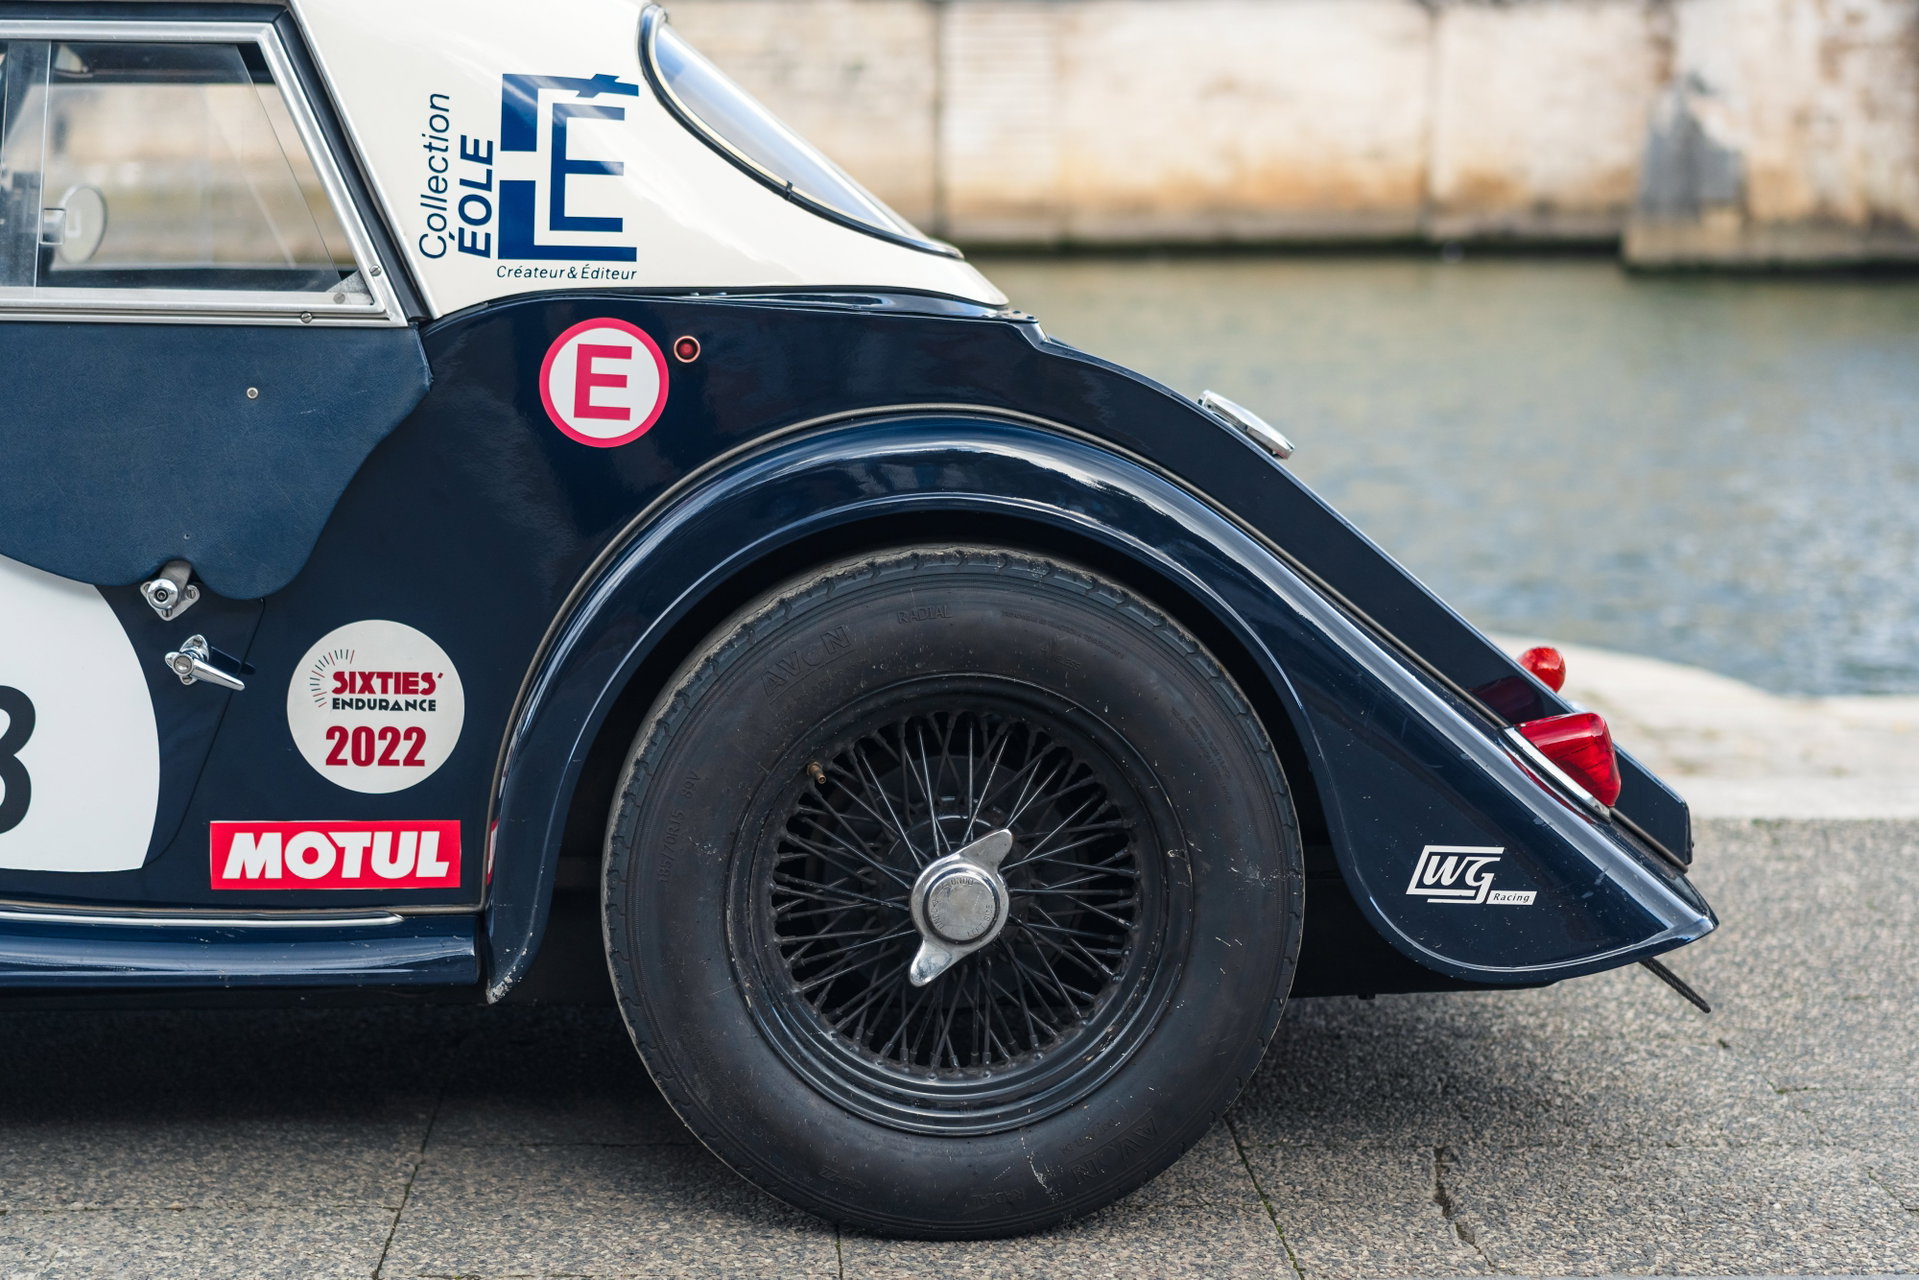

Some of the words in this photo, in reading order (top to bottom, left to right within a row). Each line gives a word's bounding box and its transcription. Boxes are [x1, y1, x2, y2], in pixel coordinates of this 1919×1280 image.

[418, 93, 450, 259] Collection
[449, 134, 494, 259] ÉOLE
[573, 343, 633, 421] E
[897, 603, 953, 625] RADIAL
[331, 697, 437, 713] ENDURANCE
[325, 724, 428, 768] 2022
[221, 830, 450, 880] MOTUL
[1493, 892, 1531, 904] Racing
